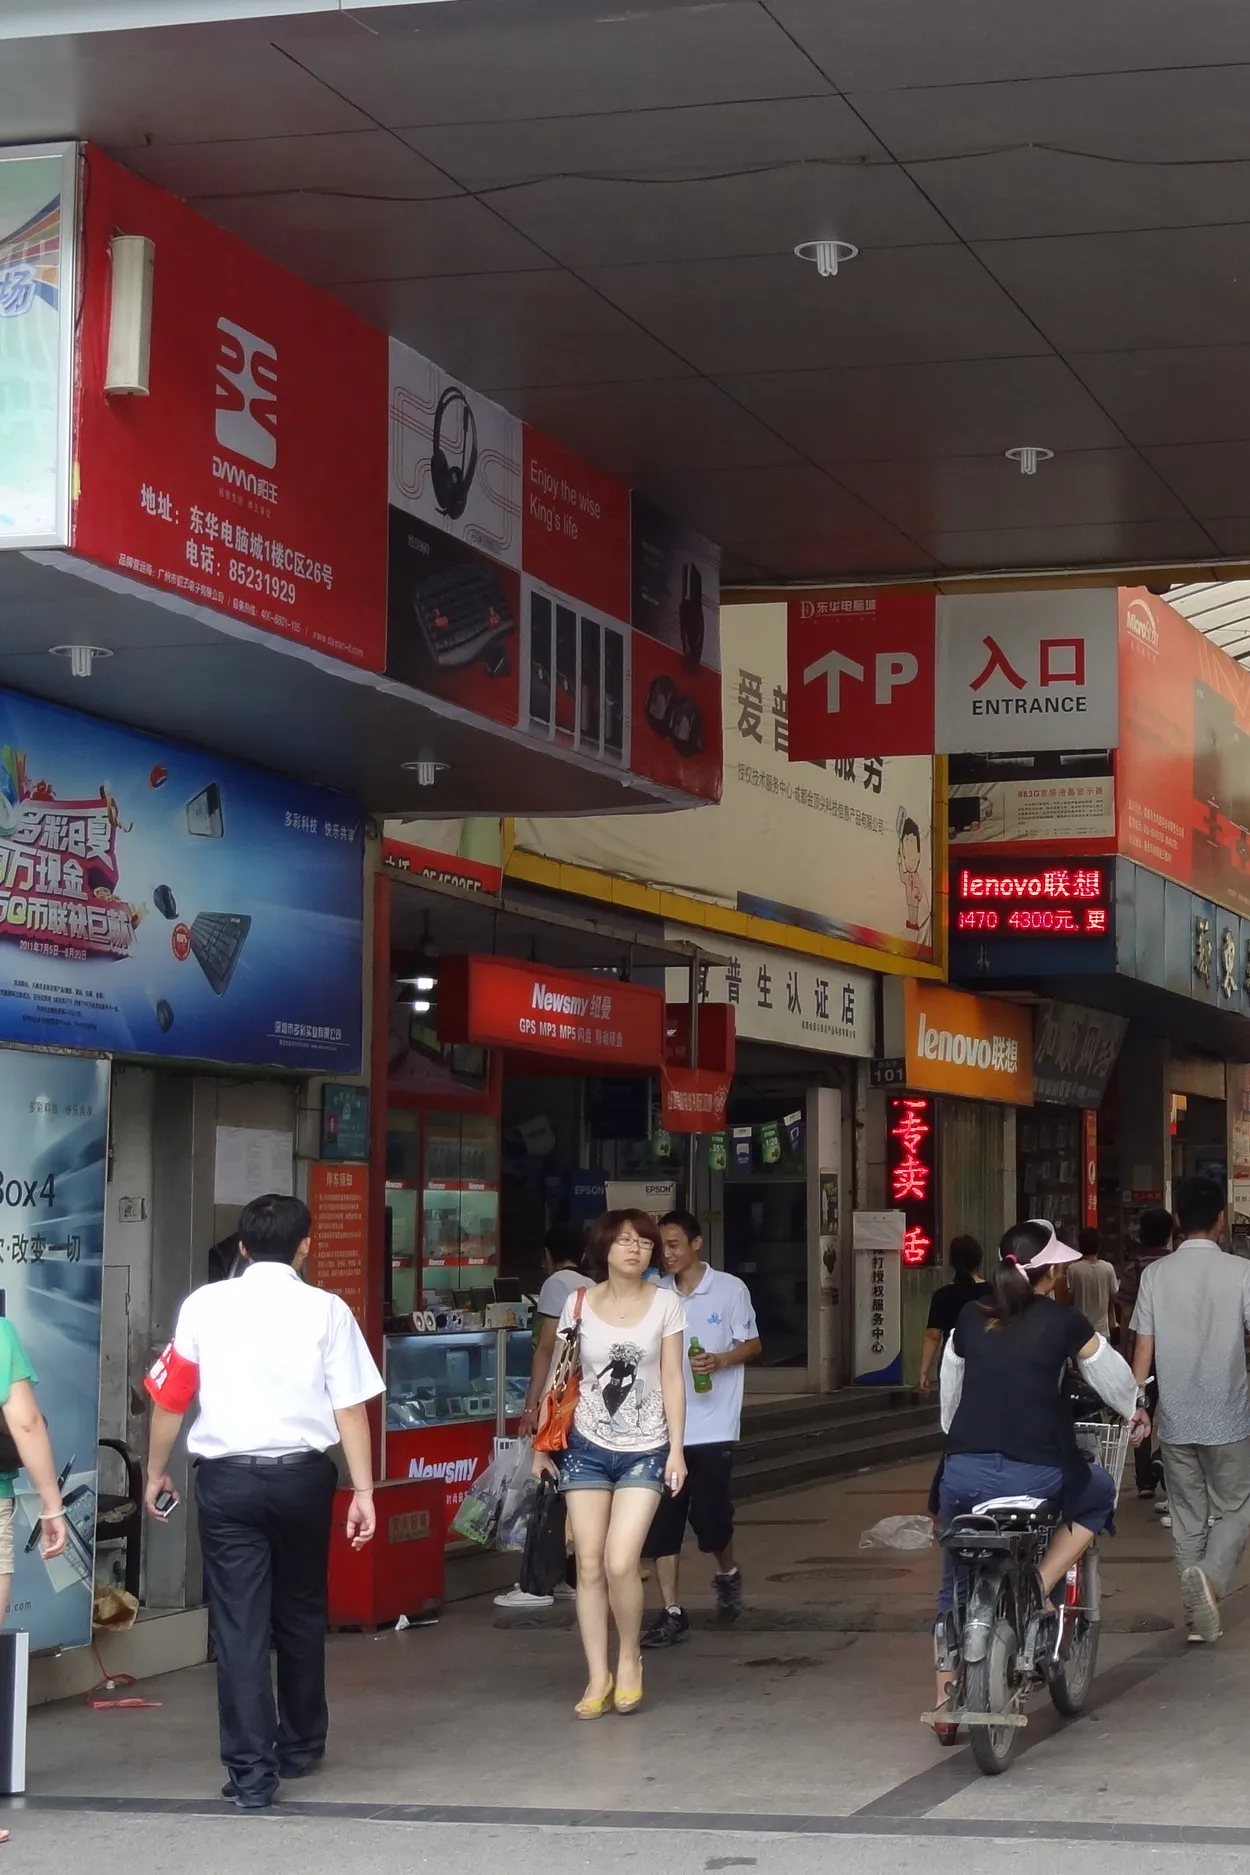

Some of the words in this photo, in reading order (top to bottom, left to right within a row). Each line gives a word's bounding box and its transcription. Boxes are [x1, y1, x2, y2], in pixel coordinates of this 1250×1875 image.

[530, 459, 559, 499] Enjoy
[561, 478, 577, 505] the
[579, 492, 600, 520] wise
[530, 495, 561, 532] King's
[563, 513, 578, 540] life
[190, 505, 333, 590] 东华电脑城1楼C区26号
[229, 559, 296, 605] 85231929
[817, 600, 876, 614] 东华电脑城
[875, 652, 919, 704] P
[969, 635, 1086, 692] 入口
[972, 697, 1088, 716] ENTRANCE
[284, 811, 318, 834] 多彩科技
[962, 870, 1101, 898] lenovo联想
[532, 983, 588, 1017] Newsmy
[519, 1018, 536, 1035] GPS
[539, 1021, 557, 1037] MP3
[559, 1024, 576, 1040] MP5
[917, 1013, 1018, 1074] lenovo联想
[574, 1184, 604, 1196] EPSON
[645, 1185, 672, 1194] EPSON
[408, 1457, 478, 1484] Newsmy
